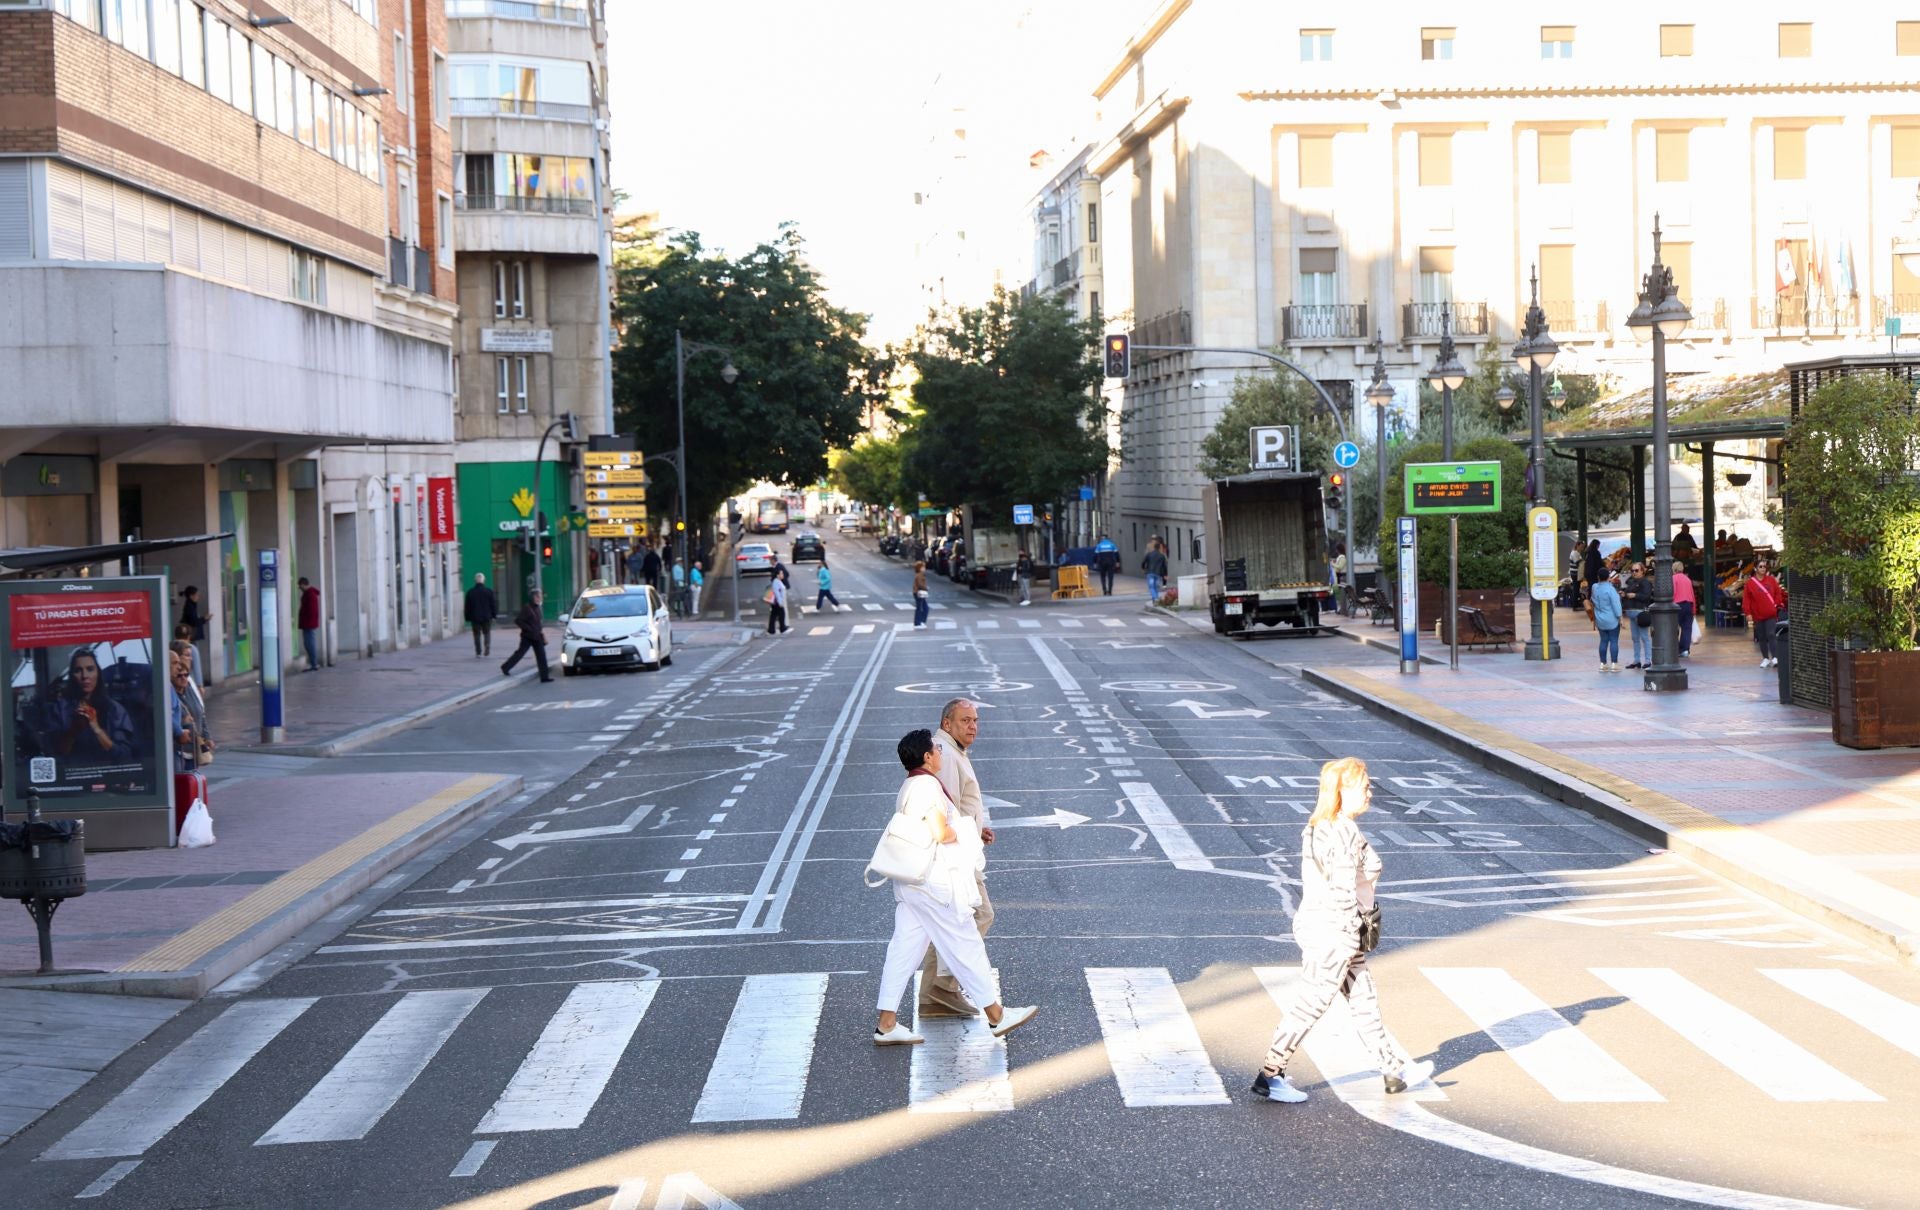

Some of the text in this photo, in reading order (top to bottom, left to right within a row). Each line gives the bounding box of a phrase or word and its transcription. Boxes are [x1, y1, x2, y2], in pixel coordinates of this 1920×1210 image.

[1257, 429, 1284, 463] P
[47, 609, 79, 619] PAGAS
[80, 608, 91, 617] EL
[91, 607, 125, 616] PRECIO
[1224, 775, 1448, 788] MOO
[1265, 800, 1478, 815] TXI
